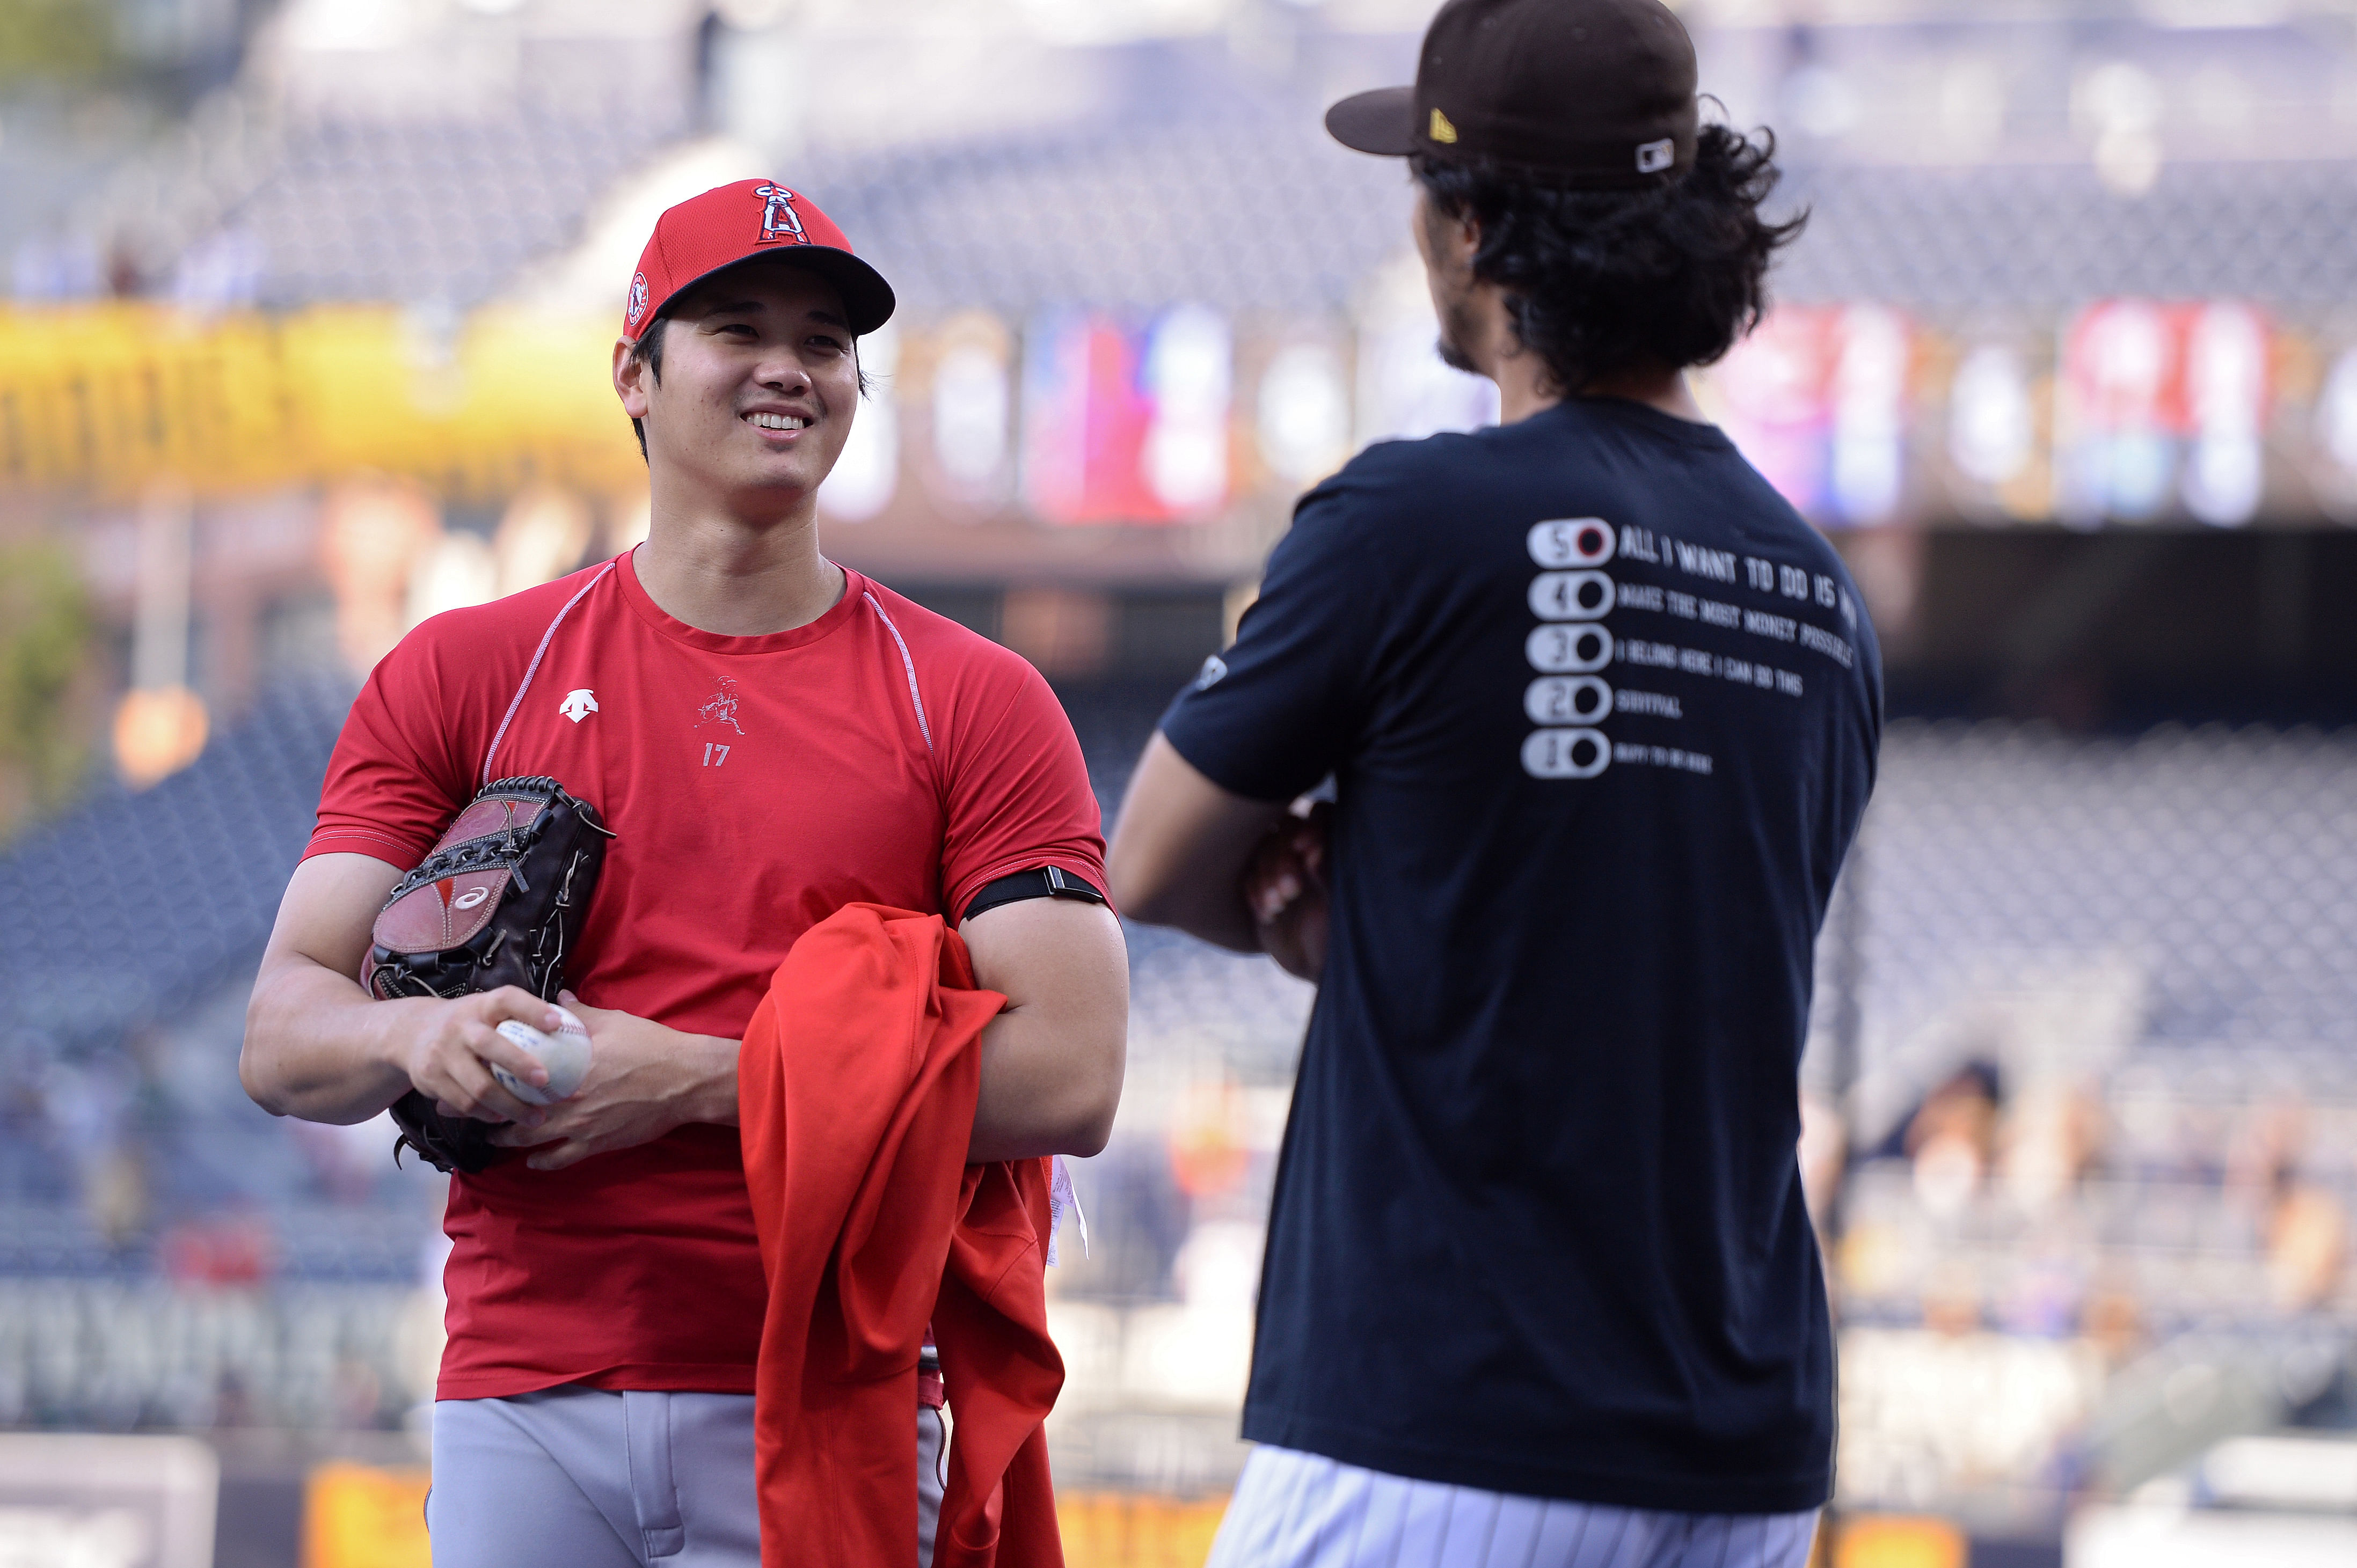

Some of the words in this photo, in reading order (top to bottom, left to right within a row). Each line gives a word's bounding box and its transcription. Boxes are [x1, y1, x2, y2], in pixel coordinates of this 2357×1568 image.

[1552, 524, 1568, 559] 5
[1618, 524, 1660, 563] ALL
[1661, 534, 1674, 568] I
[1674, 539, 1737, 585] WANT
[1744, 556, 1774, 592] TO
[1779, 565, 1808, 602] DO
[1814, 573, 1836, 609] IS
[1617, 582, 1665, 613] MAKE
[1666, 589, 1698, 620] THE
[1698, 598, 1741, 629] MOST
[1743, 609, 1797, 643] MONEY
[1799, 622, 1853, 670] POSSIBLE
[1614, 639, 1625, 662] I
[1678, 647, 1713, 676] HERE
[1713, 655, 1723, 678] I
[1723, 656, 1753, 684] CAN
[1753, 663, 1774, 689] DO
[1775, 668, 1803, 697] THIS
[703, 742, 731, 767] 17
